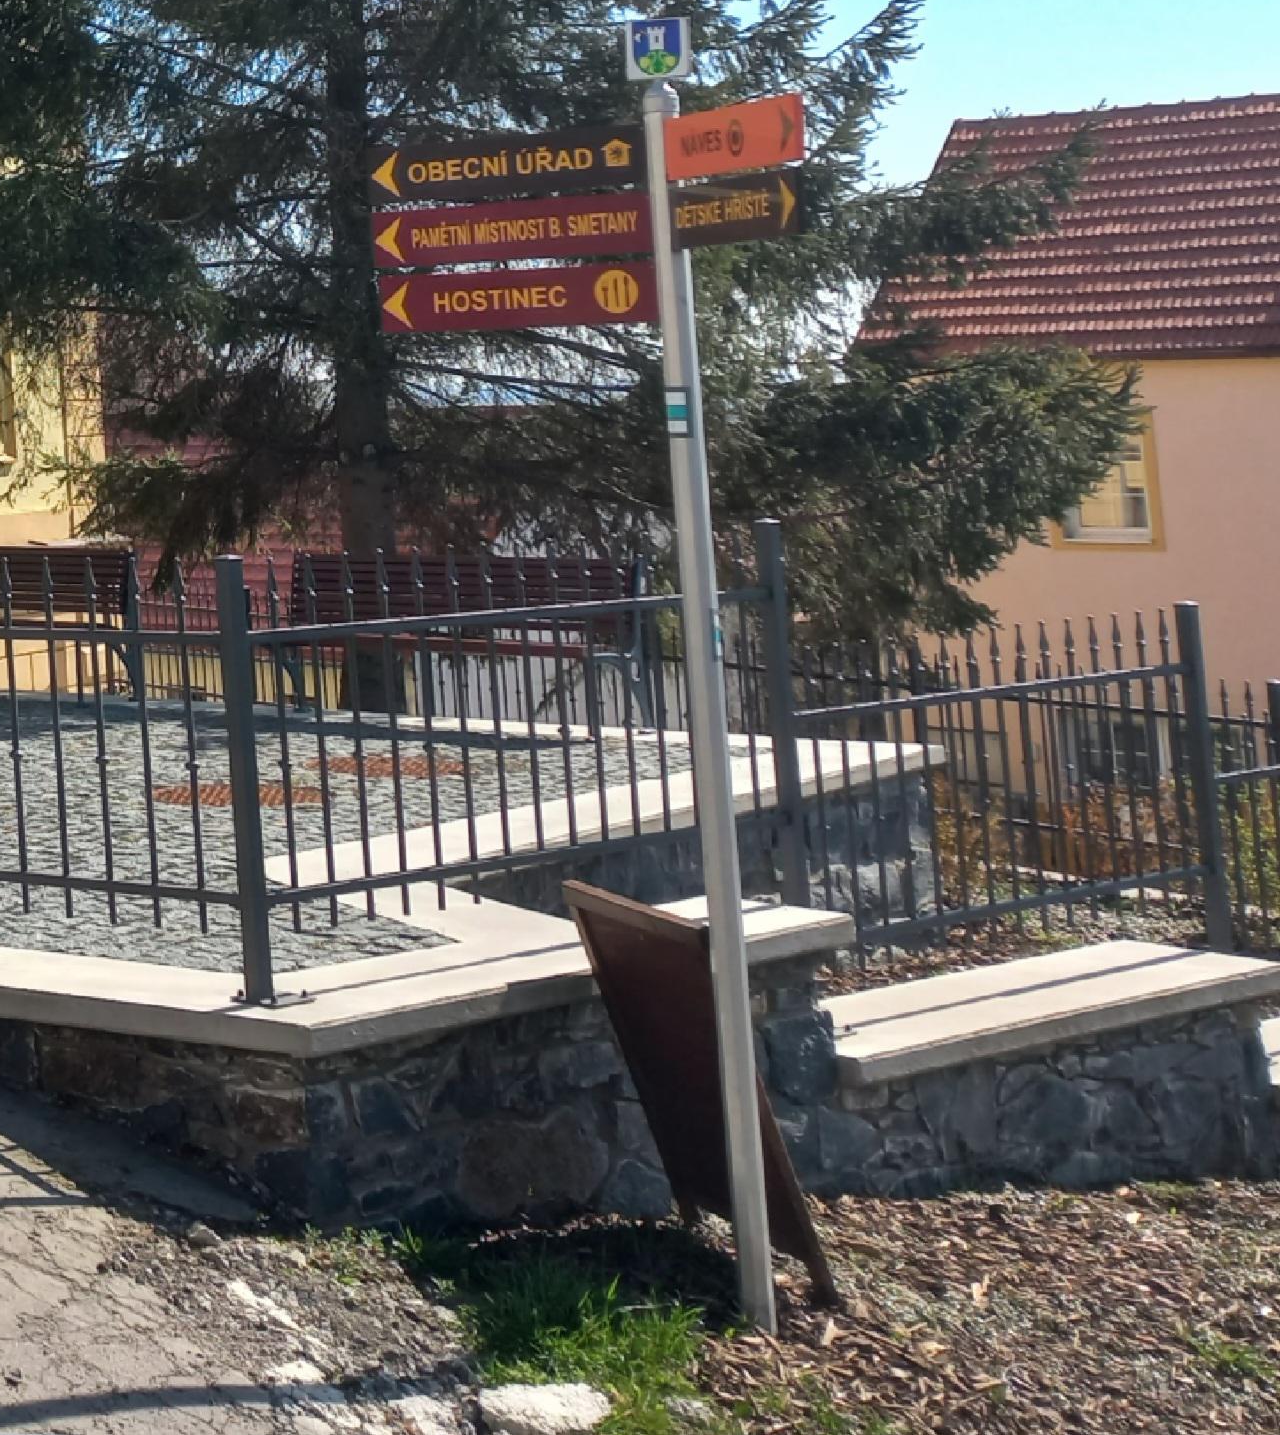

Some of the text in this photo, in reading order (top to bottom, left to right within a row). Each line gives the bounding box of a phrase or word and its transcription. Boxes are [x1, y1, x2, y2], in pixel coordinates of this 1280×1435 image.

[407, 146, 593, 184] OBECNÍ ÚŘAD
[411, 211, 638, 249] PAMĚTNÍ MÍSTNOST B. SMETANY
[432, 285, 568, 314] HOSTINEC
